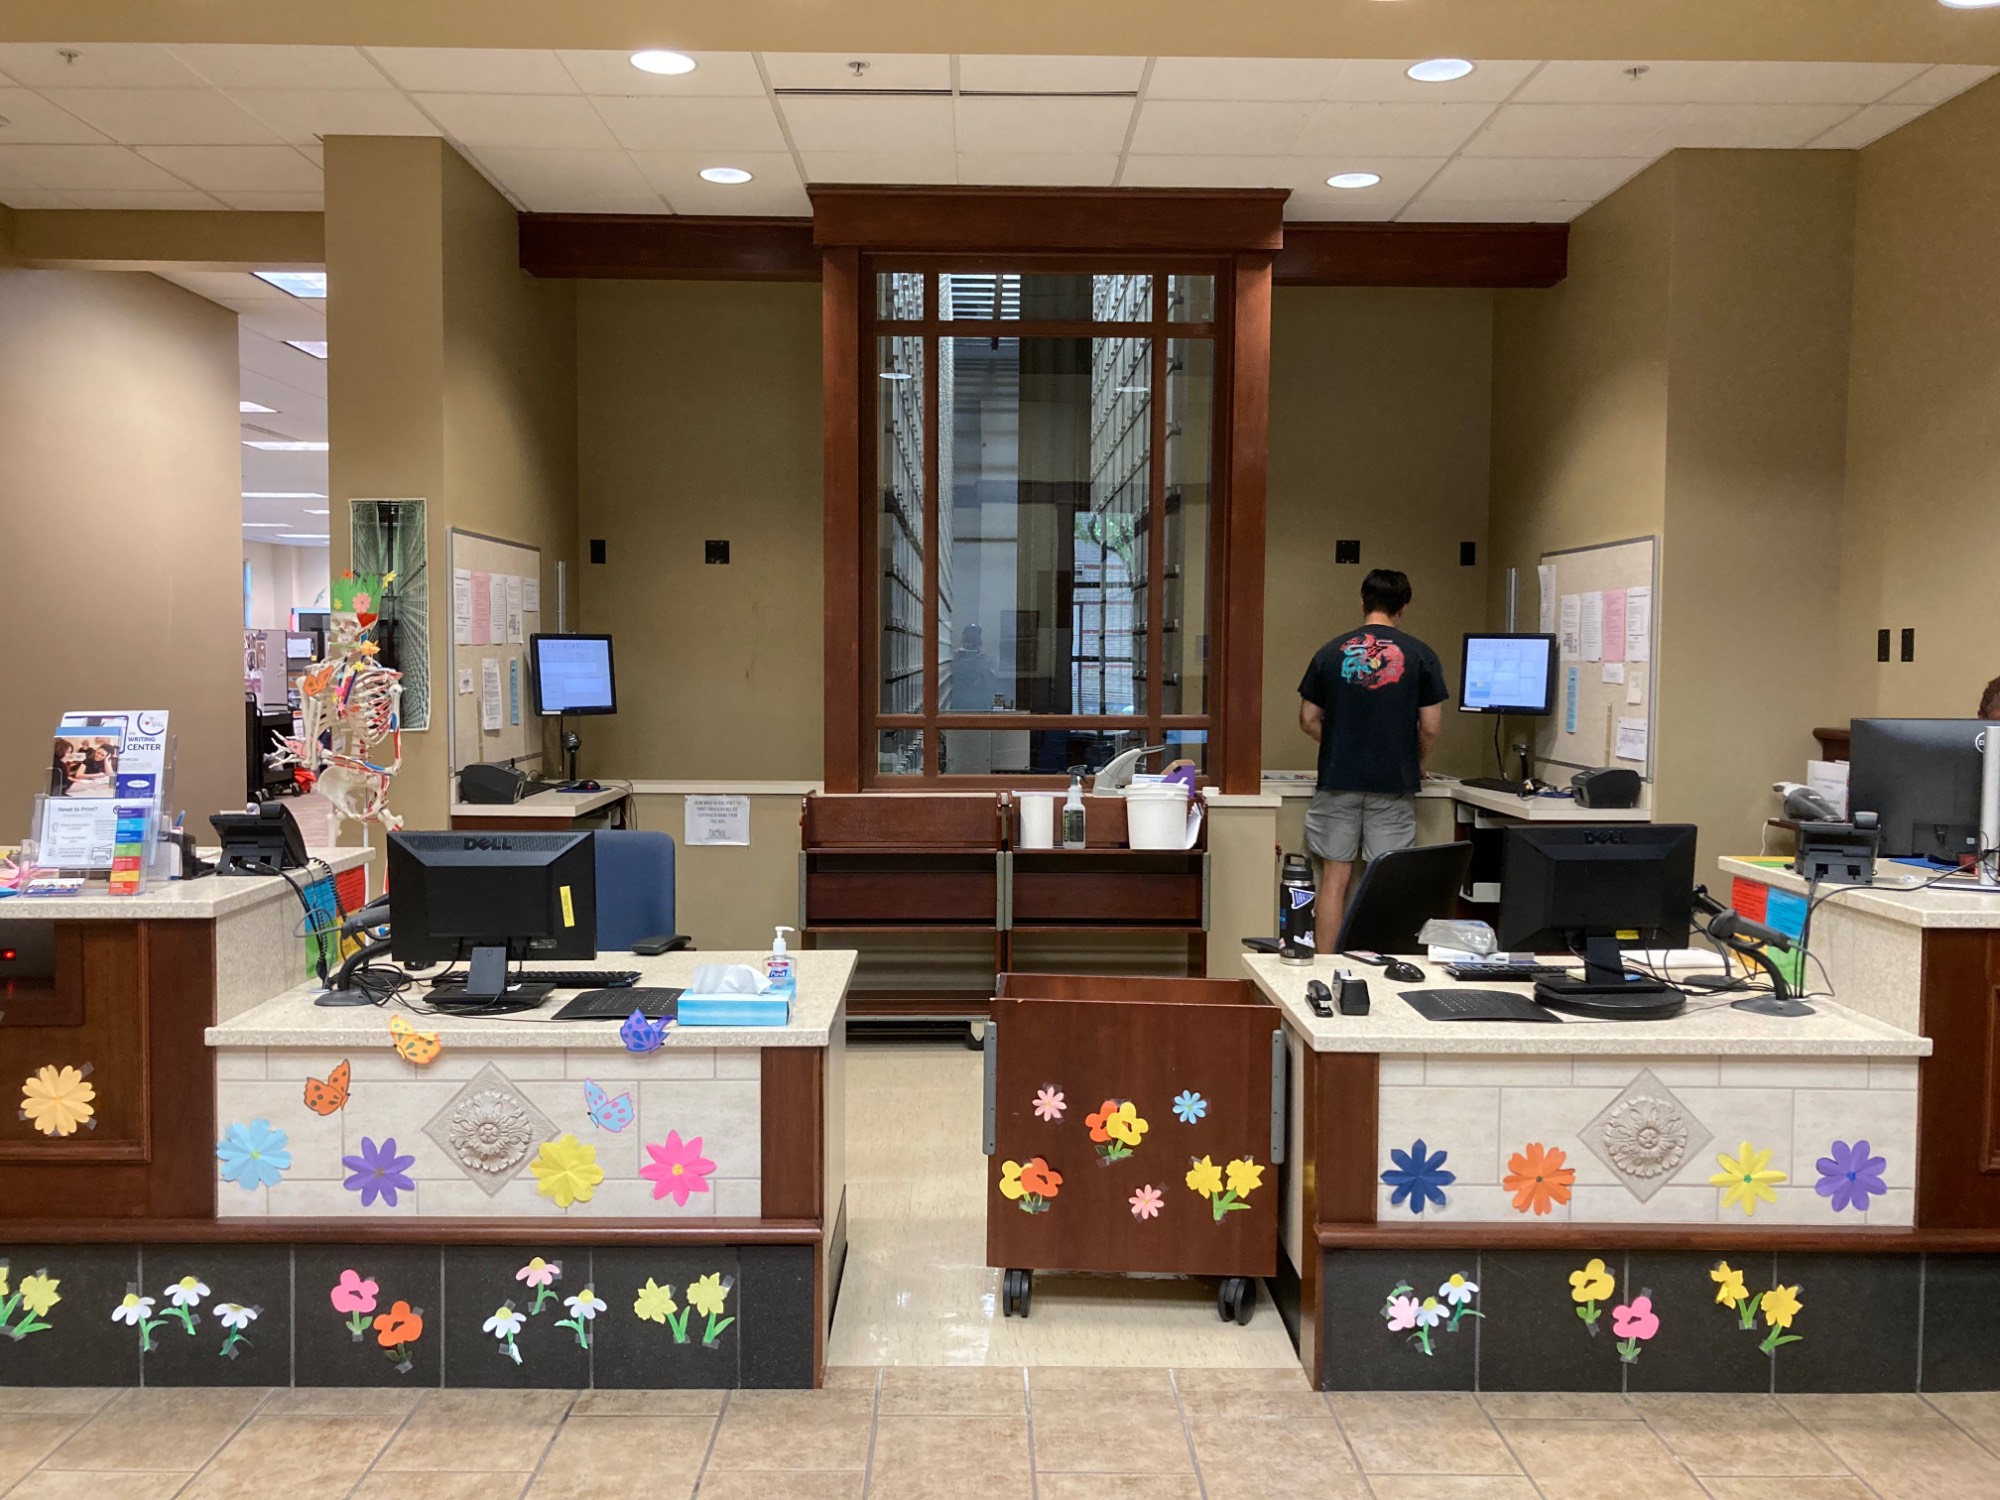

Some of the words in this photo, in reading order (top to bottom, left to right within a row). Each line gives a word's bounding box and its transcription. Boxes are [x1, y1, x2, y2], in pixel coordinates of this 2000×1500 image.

[127, 743, 161, 751] CENTER
[464, 837, 512, 851] DELL
[1584, 831, 1629, 845] DELL
